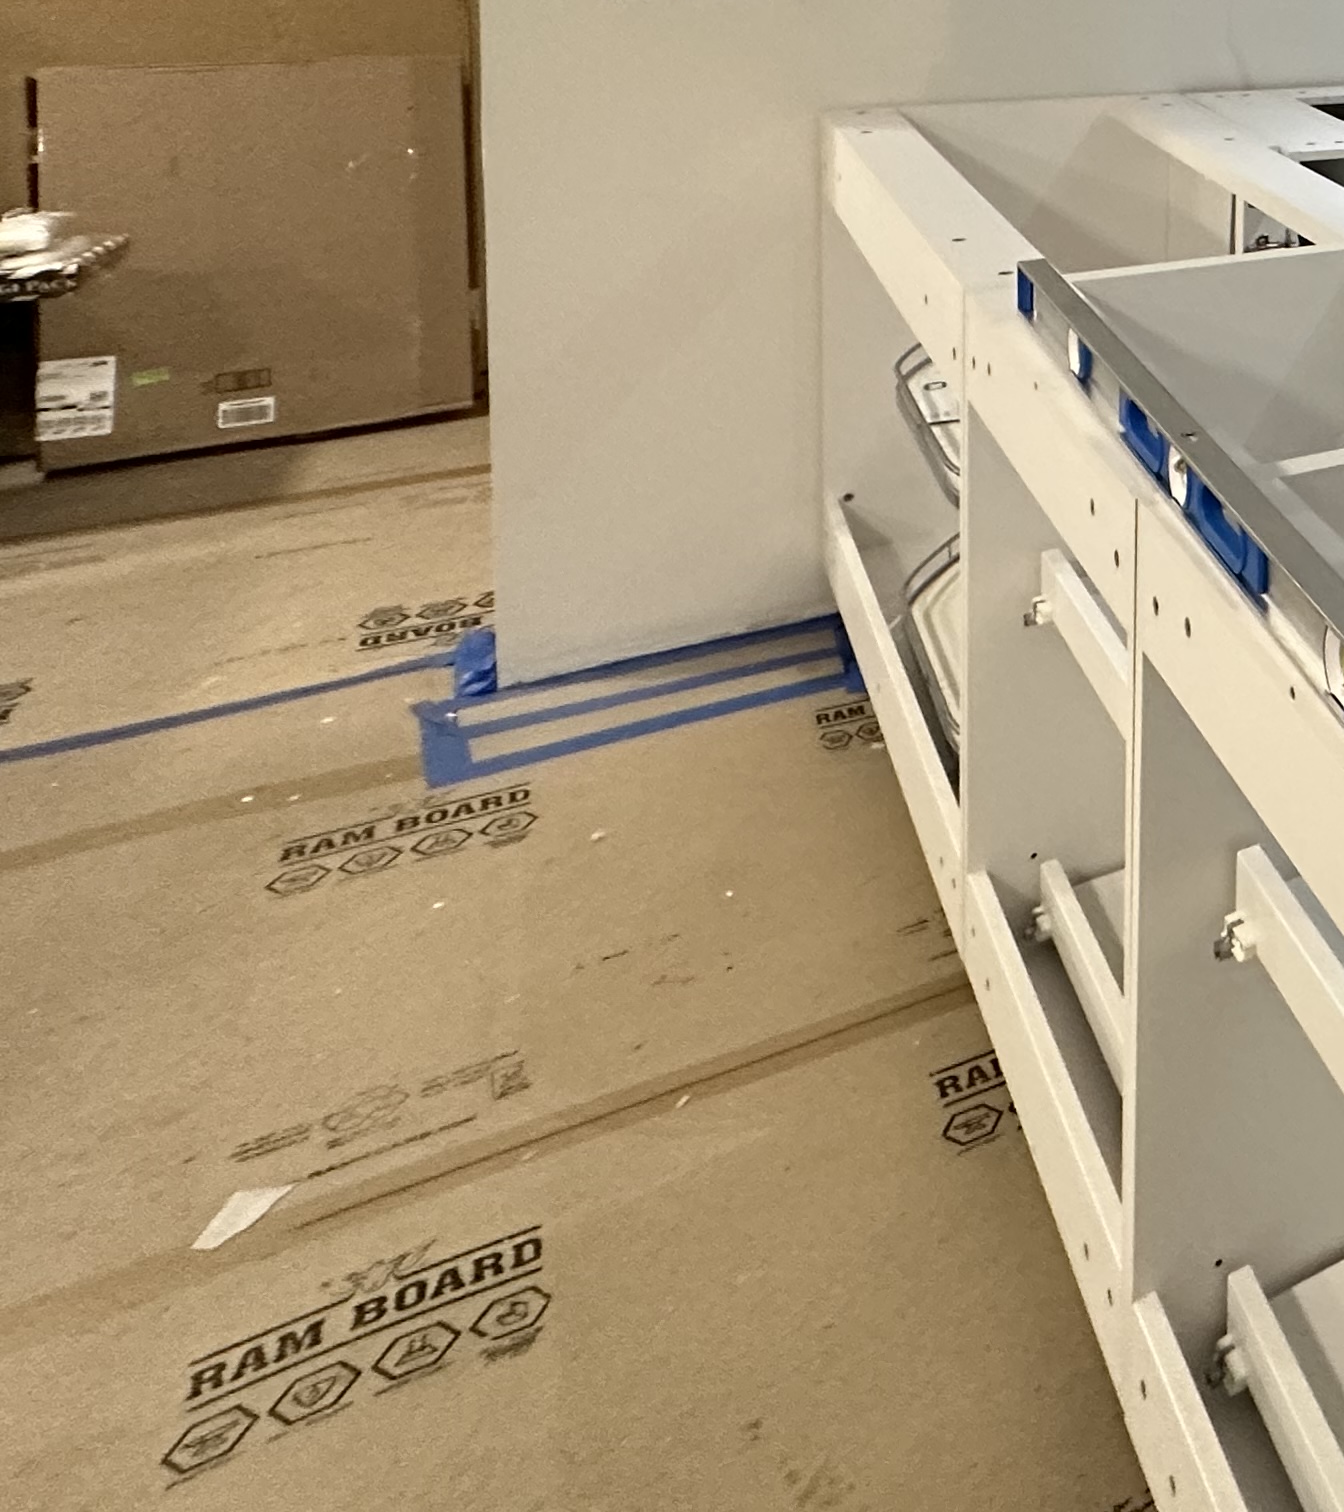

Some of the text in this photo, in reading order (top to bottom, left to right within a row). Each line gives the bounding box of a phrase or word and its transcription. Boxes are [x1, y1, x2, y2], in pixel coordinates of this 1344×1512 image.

[359, 615, 482, 647] BOARD
[815, 705, 866, 725] RAM
[277, 788, 531, 863] RAM BOARD
[185, 1236, 543, 1402] RAM BOARD
